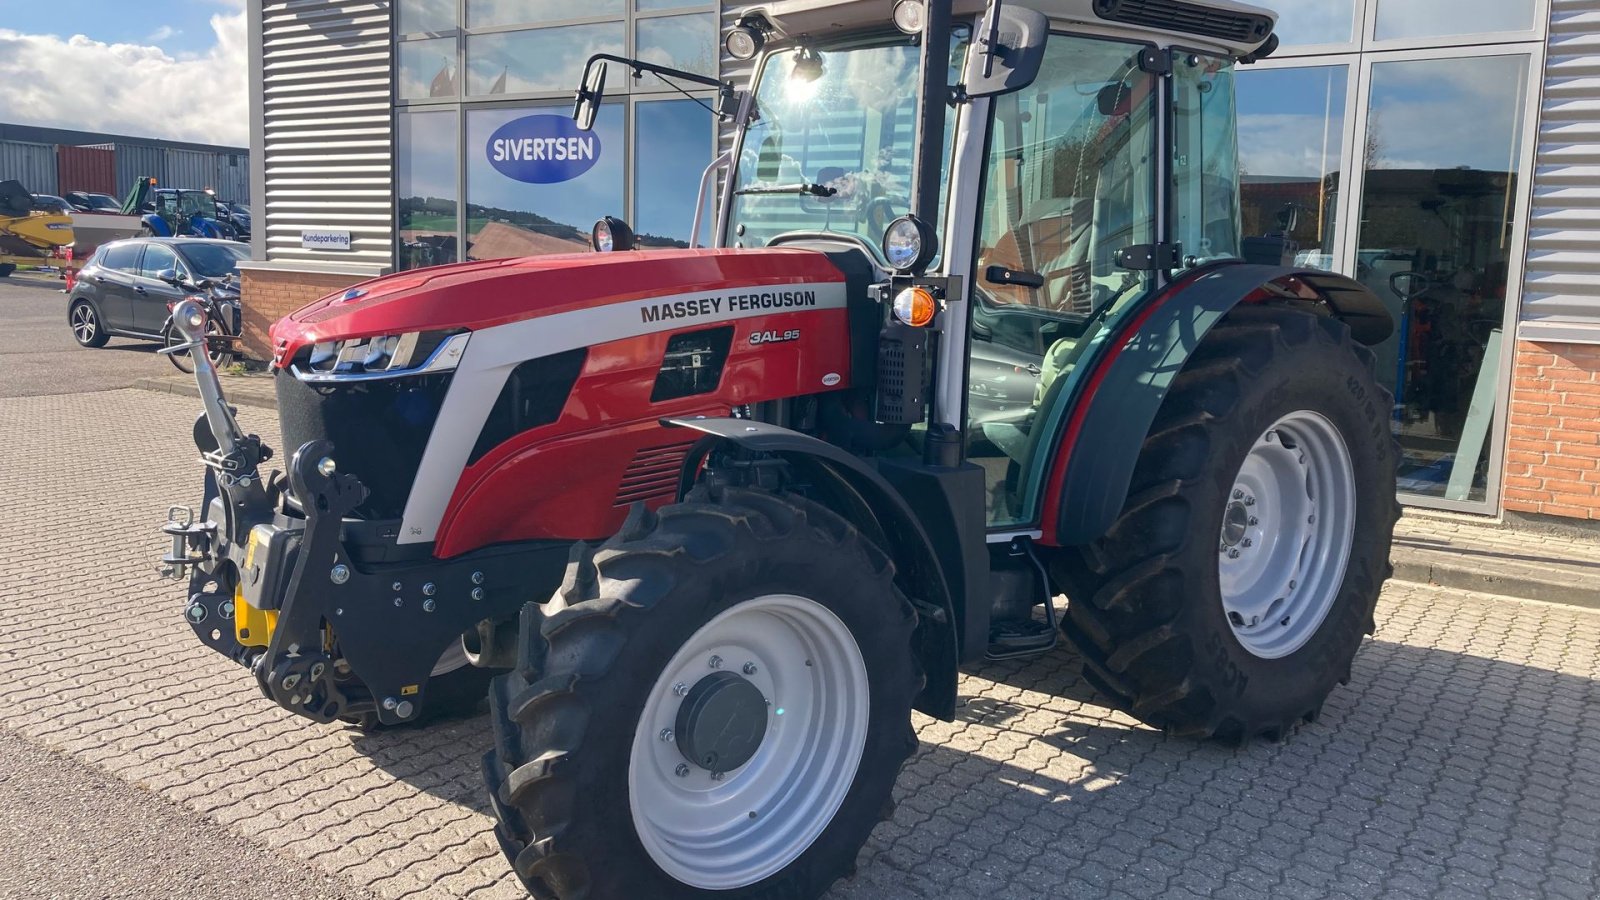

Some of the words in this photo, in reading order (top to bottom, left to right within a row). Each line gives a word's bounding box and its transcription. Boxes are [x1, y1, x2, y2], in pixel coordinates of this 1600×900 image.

[493, 136, 593, 161] SIVERTSEN
[303, 233, 349, 245] Kundeparkering
[640, 297, 721, 323] MASSEY
[728, 291, 816, 312] FERGUSON
[749, 329, 800, 344] 3AL.95
